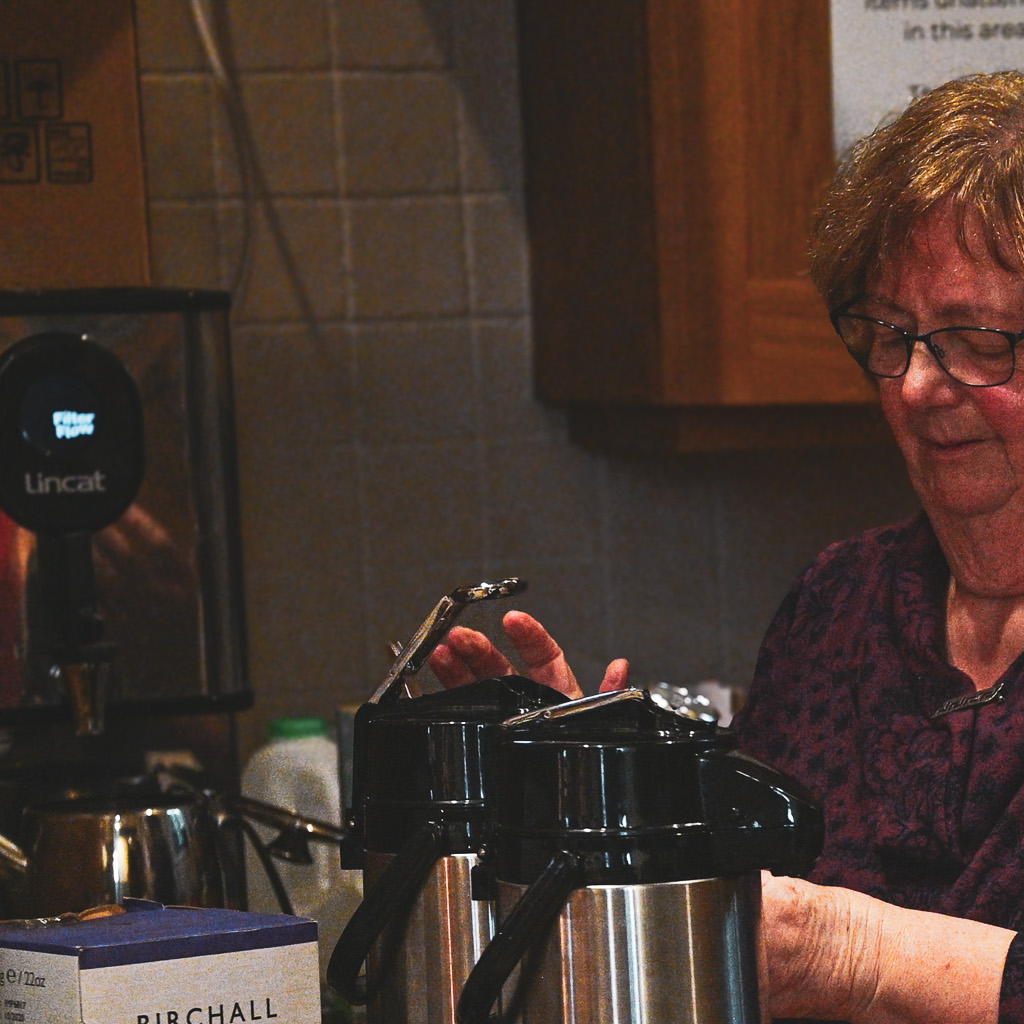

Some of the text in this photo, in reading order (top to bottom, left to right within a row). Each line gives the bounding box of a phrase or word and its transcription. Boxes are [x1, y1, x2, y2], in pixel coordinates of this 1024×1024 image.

[903, 21, 925, 40] in
[930, 21, 973, 41] this
[25, 469, 106, 494] Lincat
